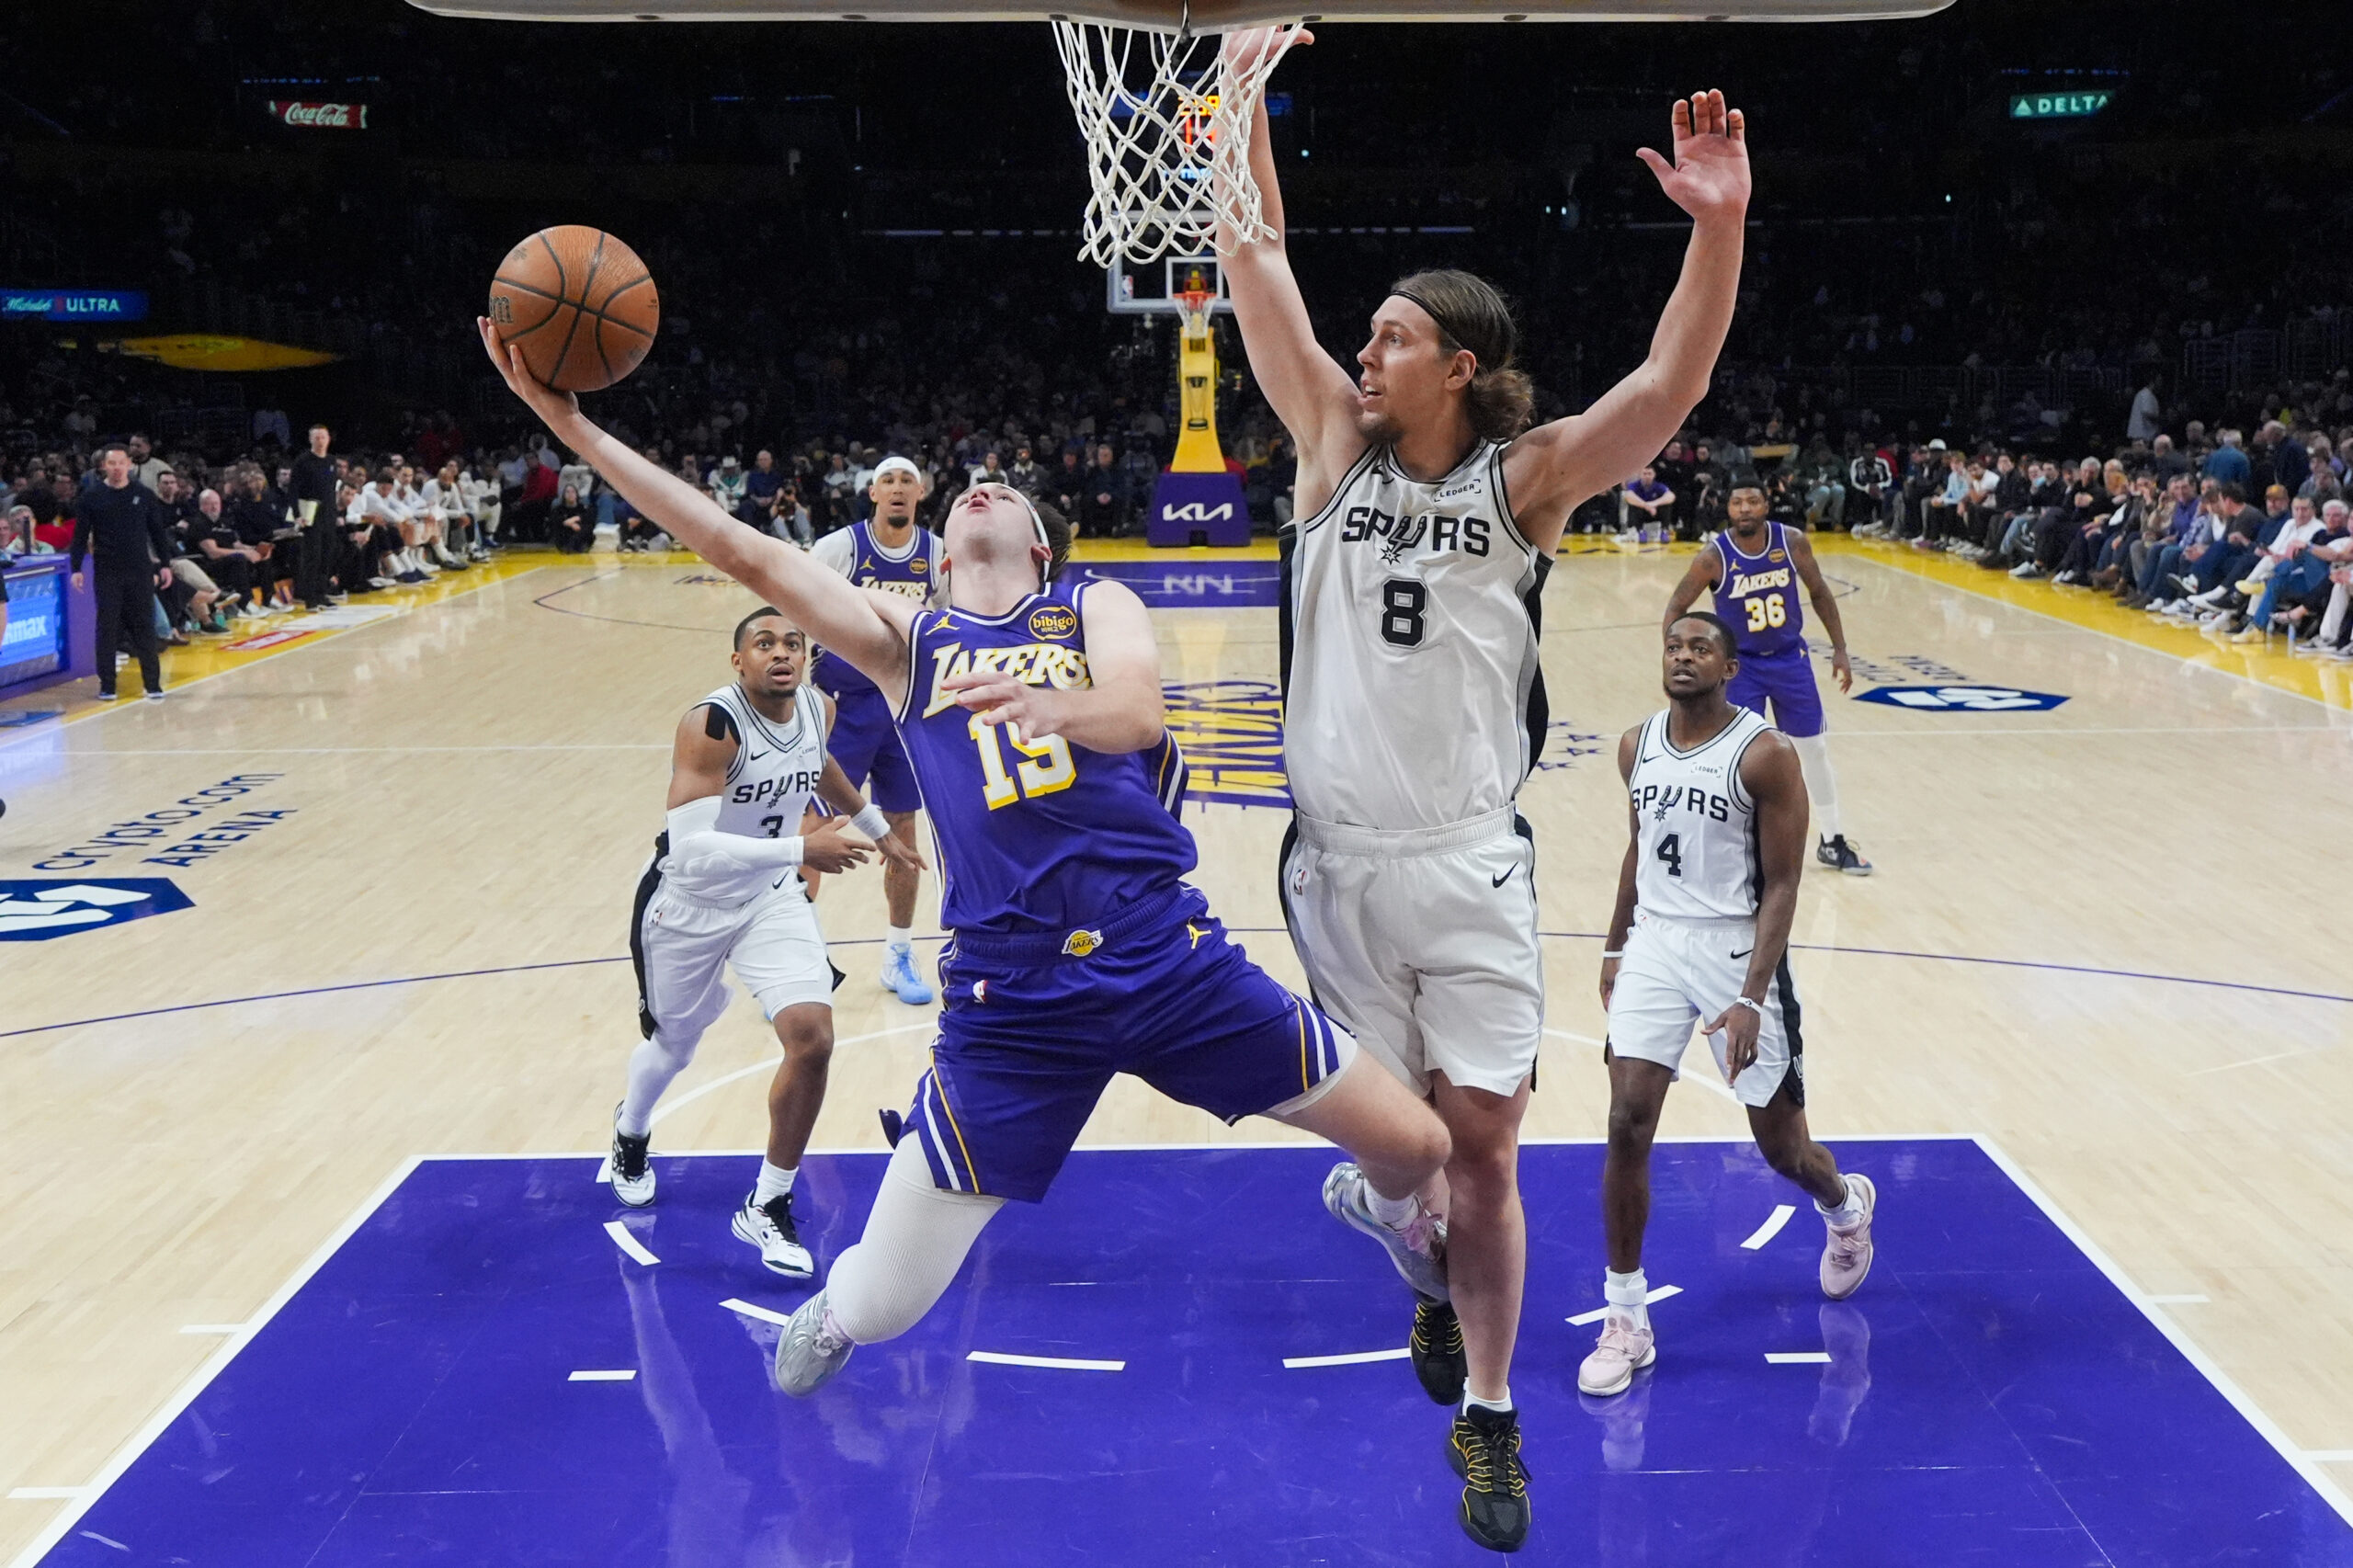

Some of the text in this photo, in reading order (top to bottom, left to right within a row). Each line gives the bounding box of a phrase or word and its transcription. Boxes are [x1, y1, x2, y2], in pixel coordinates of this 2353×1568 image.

[66, 297, 120, 312] ULTRA
[1439, 483, 1475, 498] LEDGER
[1162, 503, 1233, 521] KIA
[1342, 506, 1491, 565] SPURS
[1728, 567, 1790, 599] LAKERS
[1032, 615, 1074, 631] bibigo
[1380, 577, 1428, 649] 8
[1745, 593, 1787, 632] 36
[967, 709, 1077, 812] 15
[732, 770, 820, 810] SPURS
[1631, 784, 1730, 823] SPURS
[31, 772, 286, 870] crypto.com
[139, 808, 299, 868] ARENA
[758, 814, 784, 839] 3
[1656, 832, 1682, 878] 4
